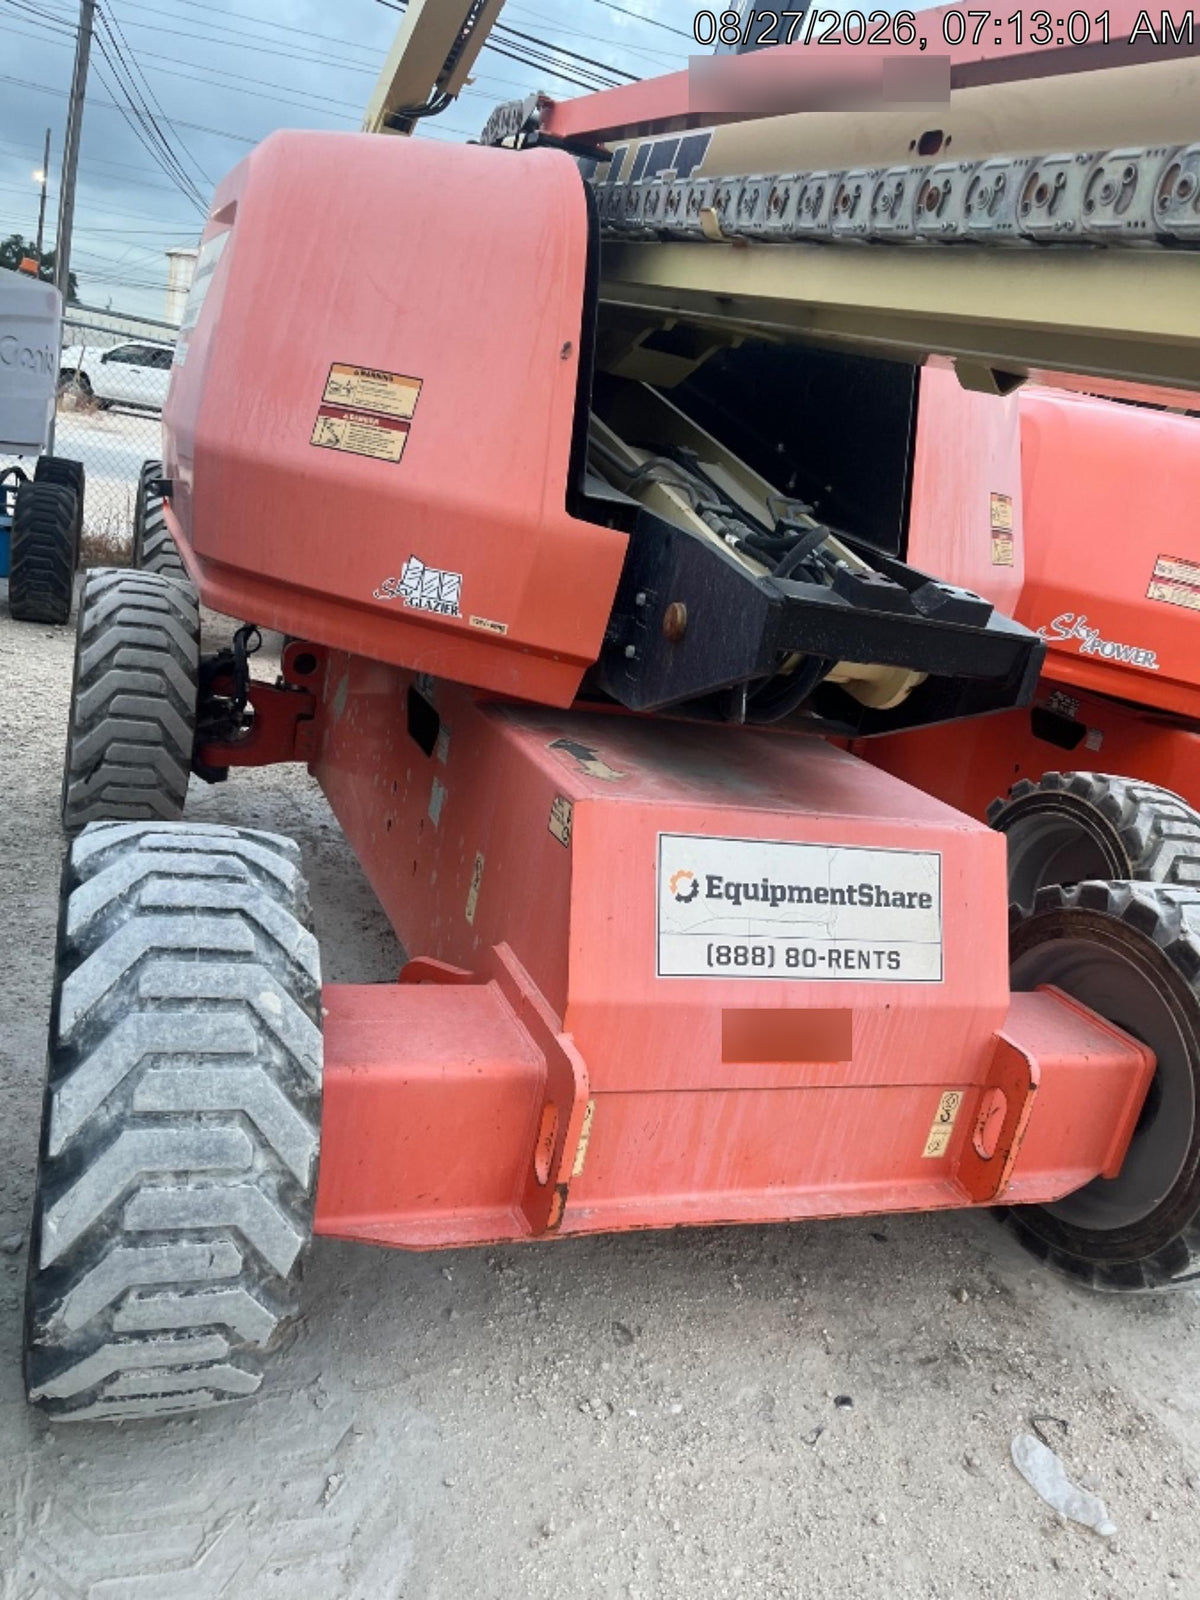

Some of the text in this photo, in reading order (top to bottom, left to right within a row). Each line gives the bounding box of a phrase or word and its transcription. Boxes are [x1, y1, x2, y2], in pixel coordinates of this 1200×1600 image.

[1036, 612, 1099, 652] Sky
[1086, 639, 1159, 669] POWER
[705, 874, 932, 909] EquipmentShare
[706, 943, 901, 970] (888) 80-RENTS
